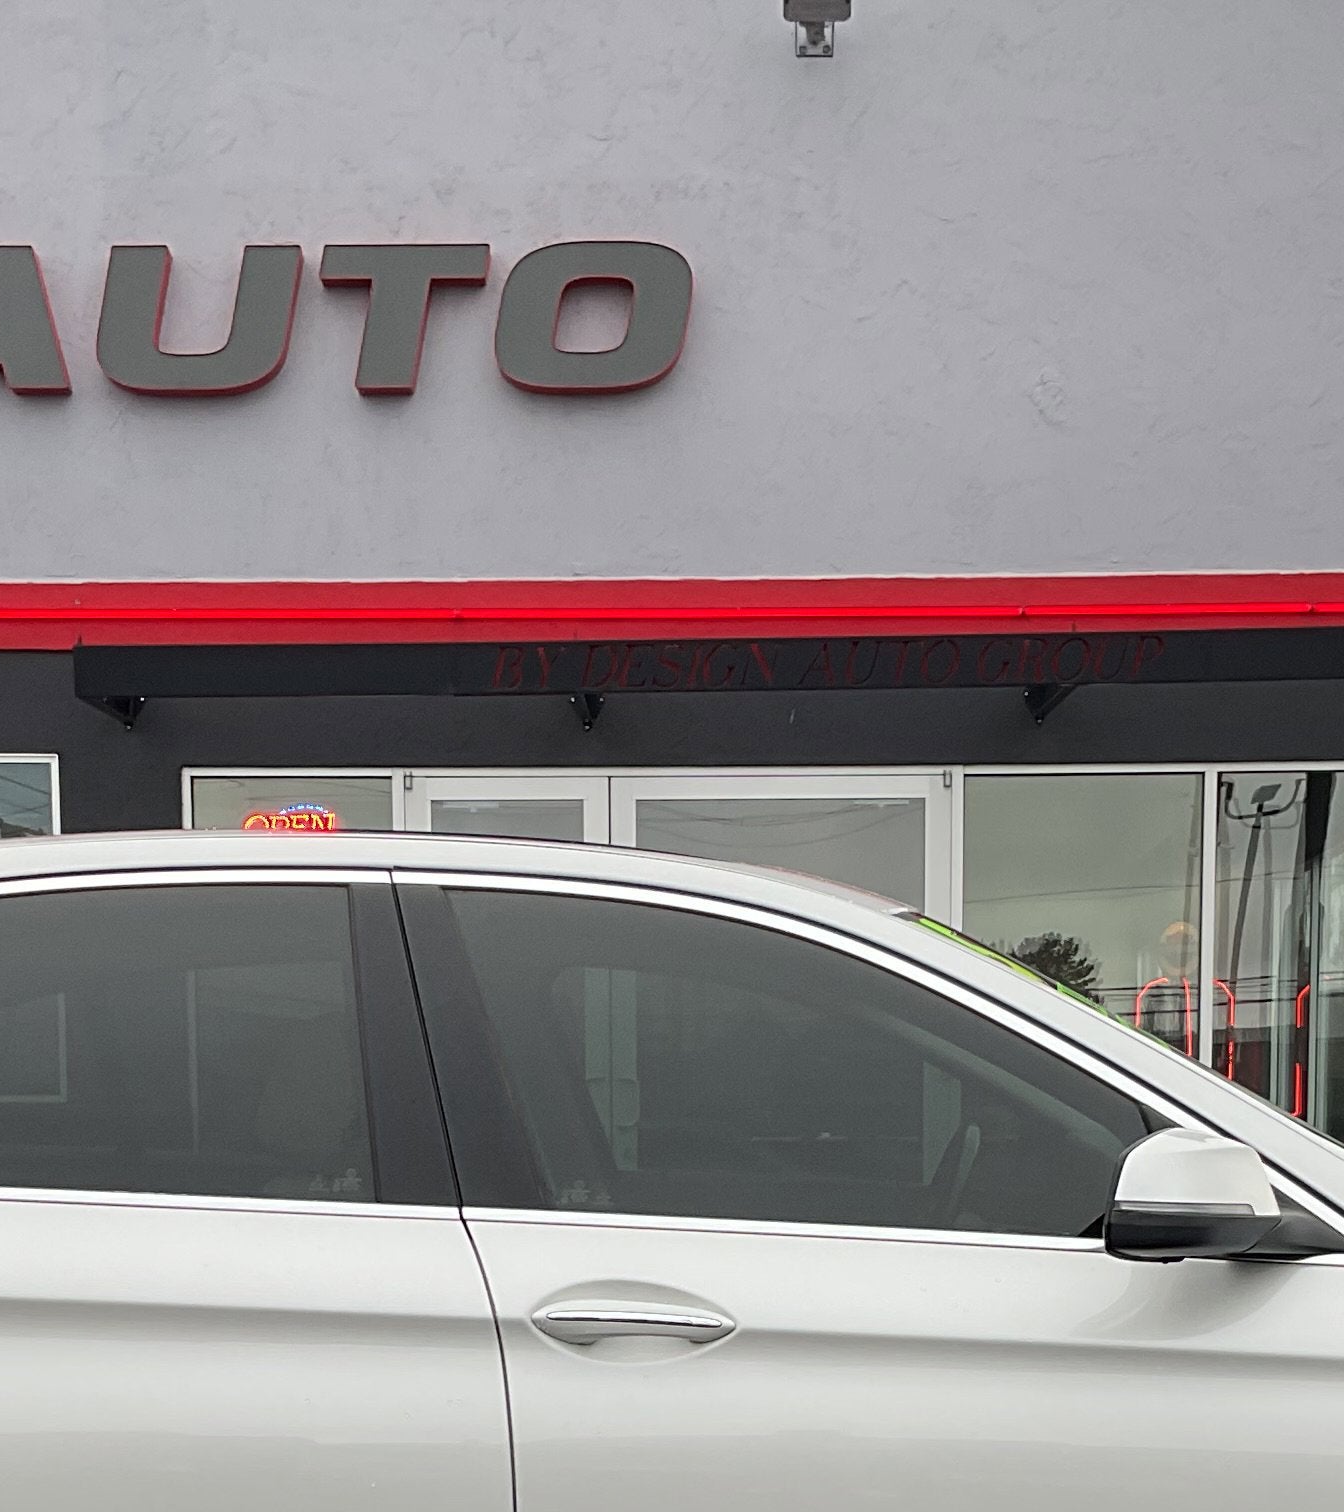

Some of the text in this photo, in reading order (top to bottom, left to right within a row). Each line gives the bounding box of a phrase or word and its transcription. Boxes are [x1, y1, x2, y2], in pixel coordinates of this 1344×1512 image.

[492, 636, 1166, 689] BY DESIGN AUTO GROUP
